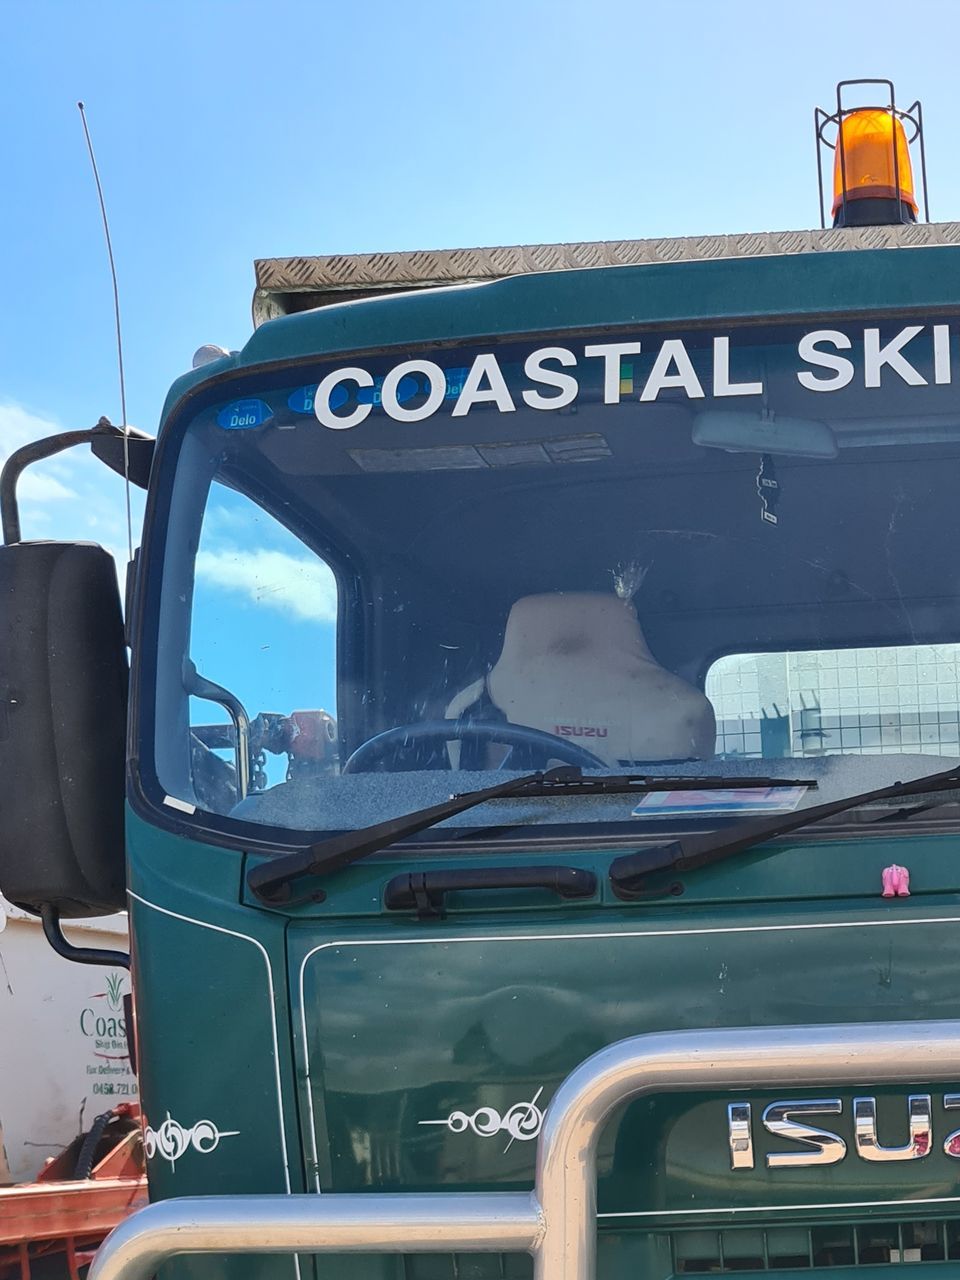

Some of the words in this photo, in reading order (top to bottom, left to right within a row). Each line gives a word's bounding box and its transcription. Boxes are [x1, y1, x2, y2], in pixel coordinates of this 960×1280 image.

[314, 336, 763, 430] COASTAL
[230, 414, 256, 427] Delo
[554, 726, 608, 738] ISUZU
[80, 1008, 126, 1038] Coas
